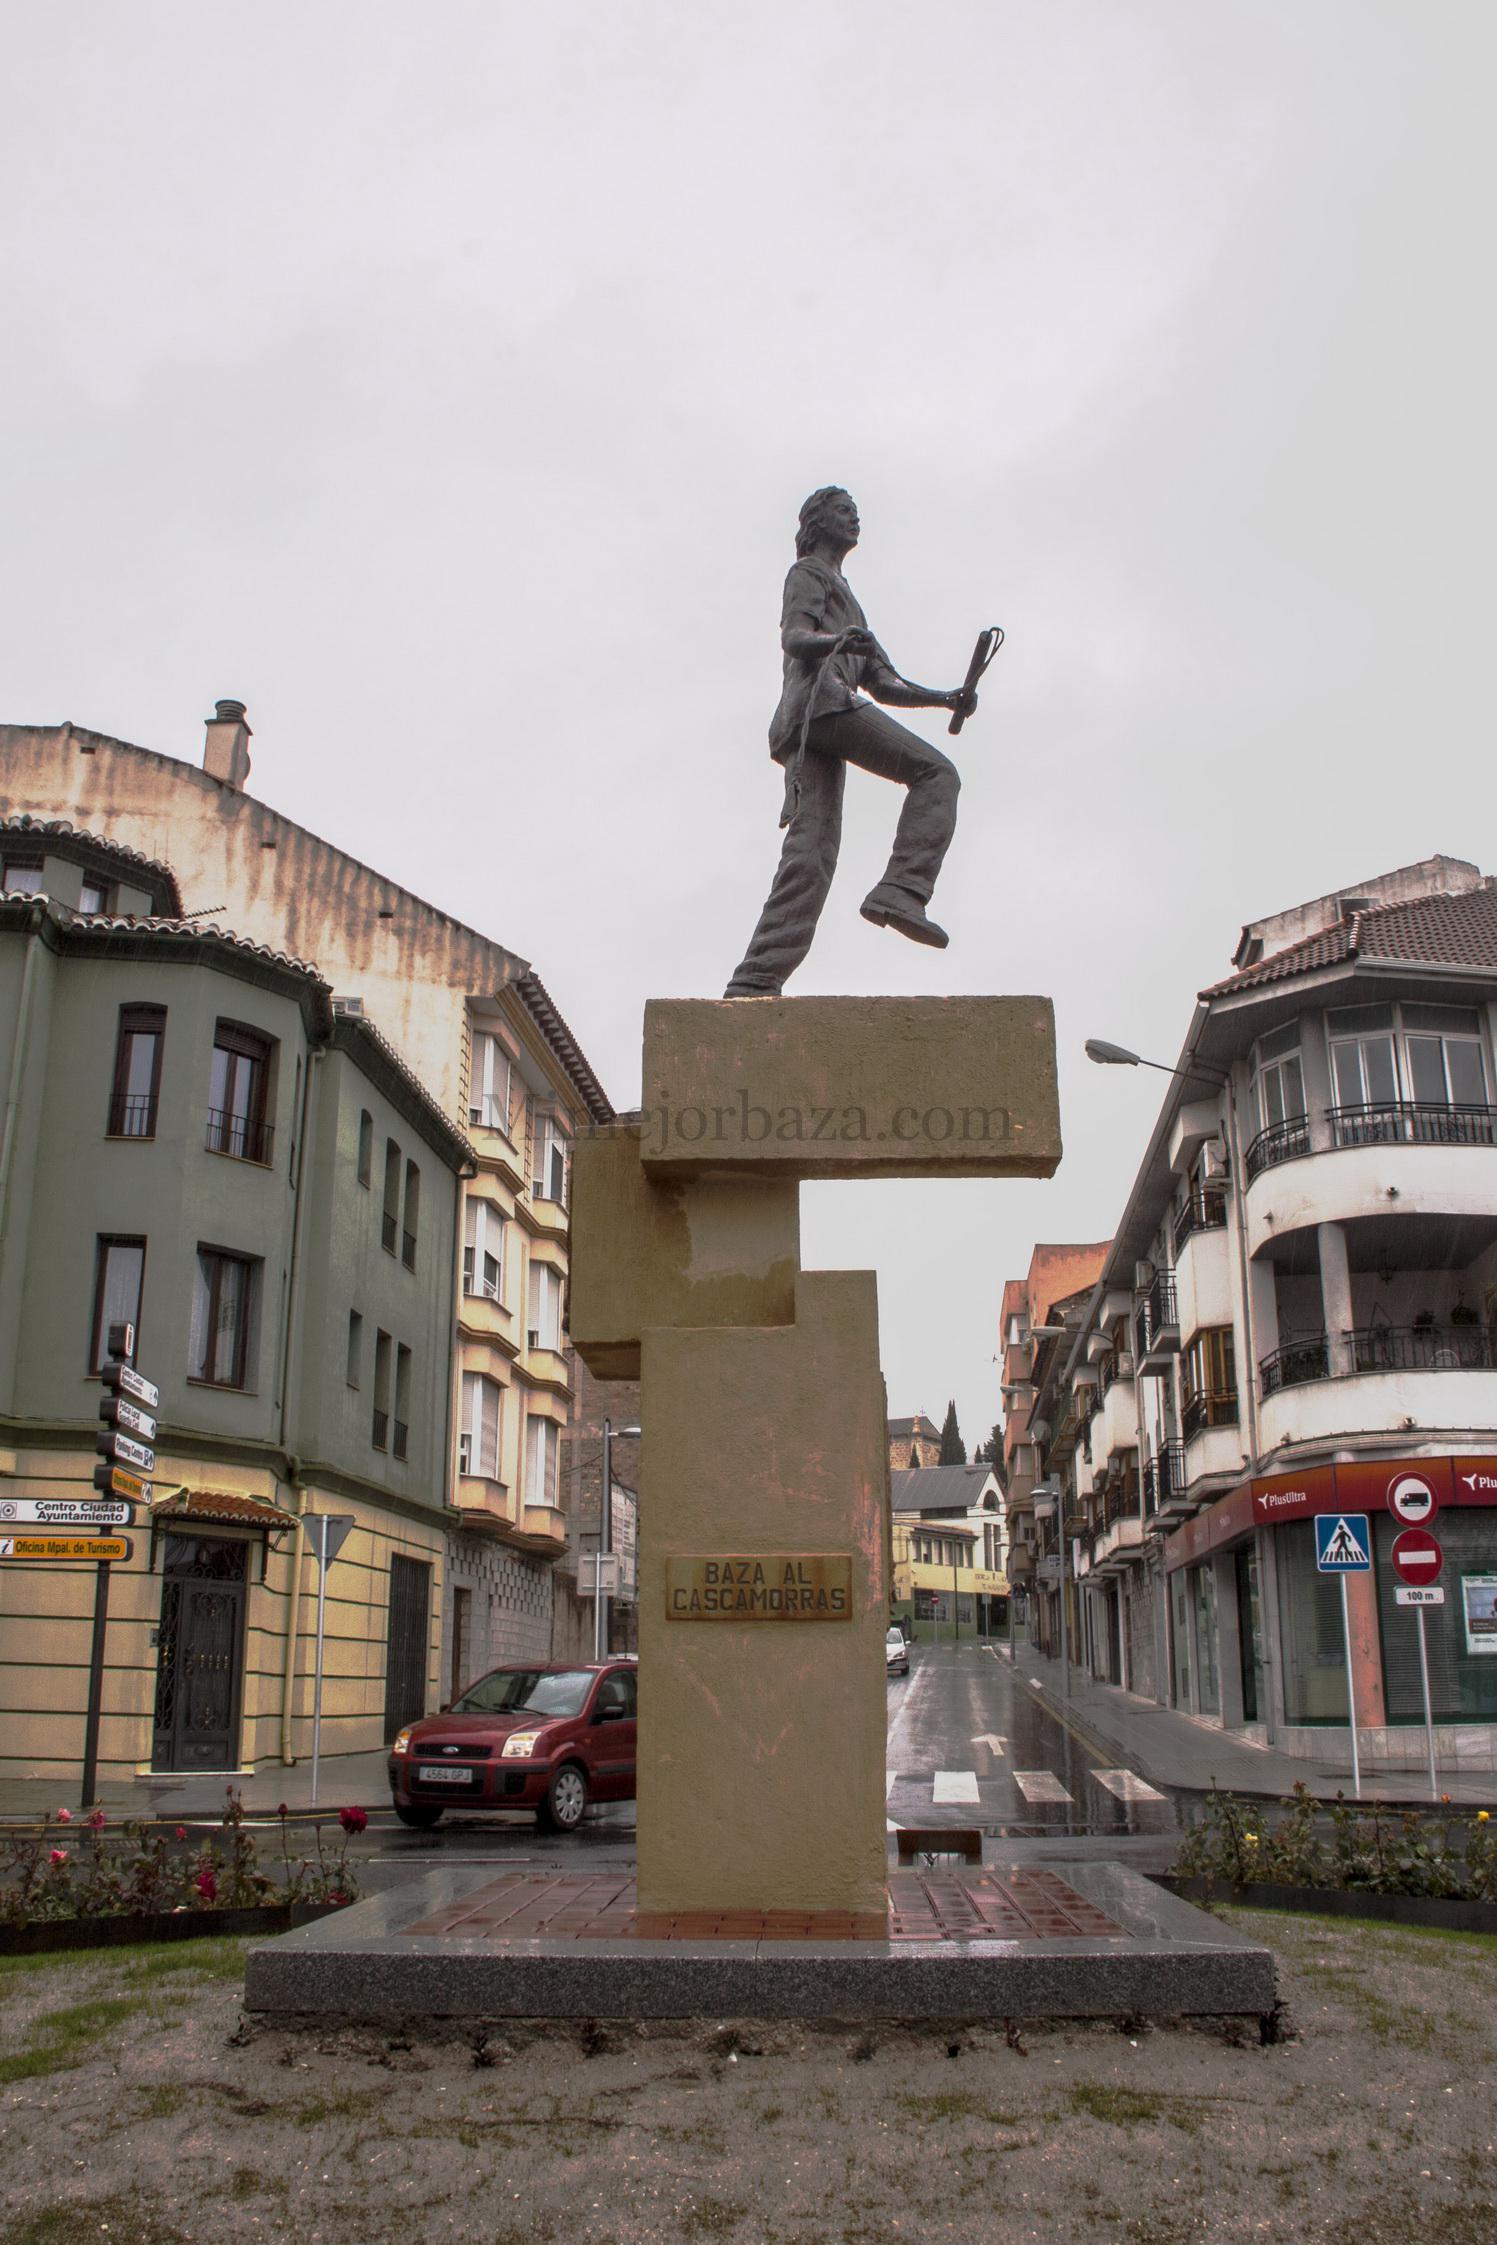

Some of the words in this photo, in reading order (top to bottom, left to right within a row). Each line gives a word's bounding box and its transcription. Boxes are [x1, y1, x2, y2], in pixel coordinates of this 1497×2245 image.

[1269, 1491, 1307, 1506] PlusUltra
[35, 1502, 77, 1512] Centro
[81, 1502, 124, 1513] Ciudad
[37, 1511, 123, 1522] Ayuntamiento
[16, 1541, 45, 1553] Oficina
[48, 1542, 70, 1556] Mpal.
[74, 1542, 84, 1553] de
[88, 1542, 120, 1554] Turismo
[704, 1561, 765, 1585] BAZA
[783, 1561, 812, 1585] AL
[673, 1588, 845, 1611] CASCAMORRAS
[1406, 1591, 1423, 1601] 100
